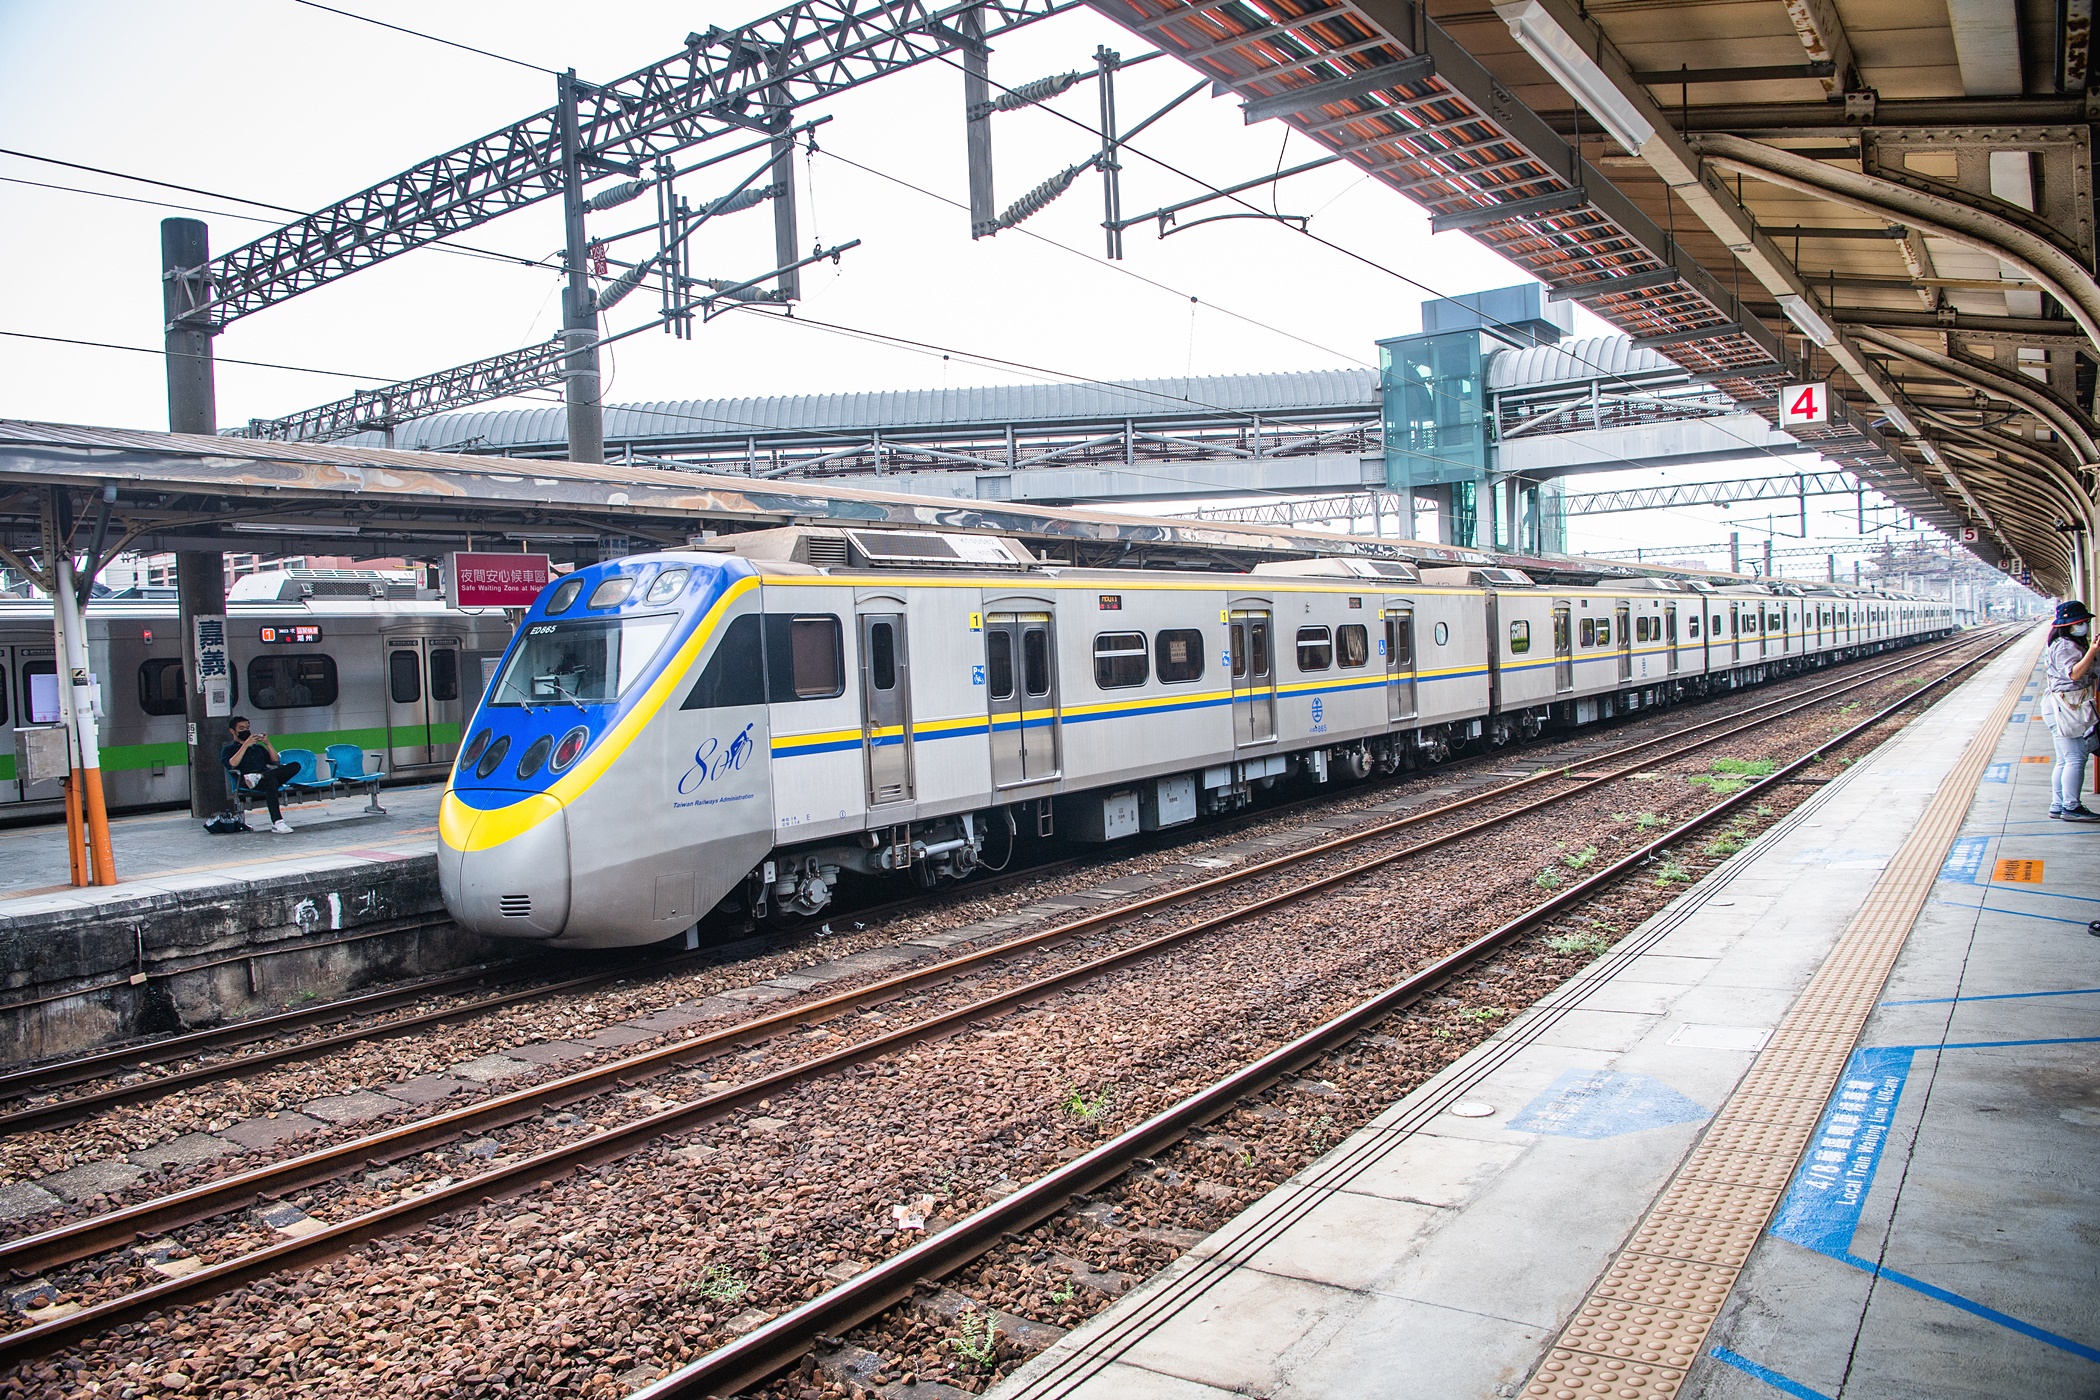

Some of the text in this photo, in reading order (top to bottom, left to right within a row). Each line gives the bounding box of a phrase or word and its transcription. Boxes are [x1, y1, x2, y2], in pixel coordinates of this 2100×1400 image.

[1790, 387, 1818, 419] 4
[1964, 529, 1974, 541] 5
[2001, 560, 2007, 568] 6
[418, 572, 425, 587] 4
[460, 569, 546, 584] 夜間安心候車區
[530, 585, 545, 593] Nigh
[973, 615, 978, 626] 1
[198, 620, 226, 676] 嘉義
[694, 798, 719, 807] Railways
[719, 793, 754, 803] Administration
[1868, 1107, 1889, 1123] Line
[1856, 1125, 1887, 1153] Waiting
[1846, 1156, 1872, 1177] Train
[1835, 1180, 1863, 1205] Local
